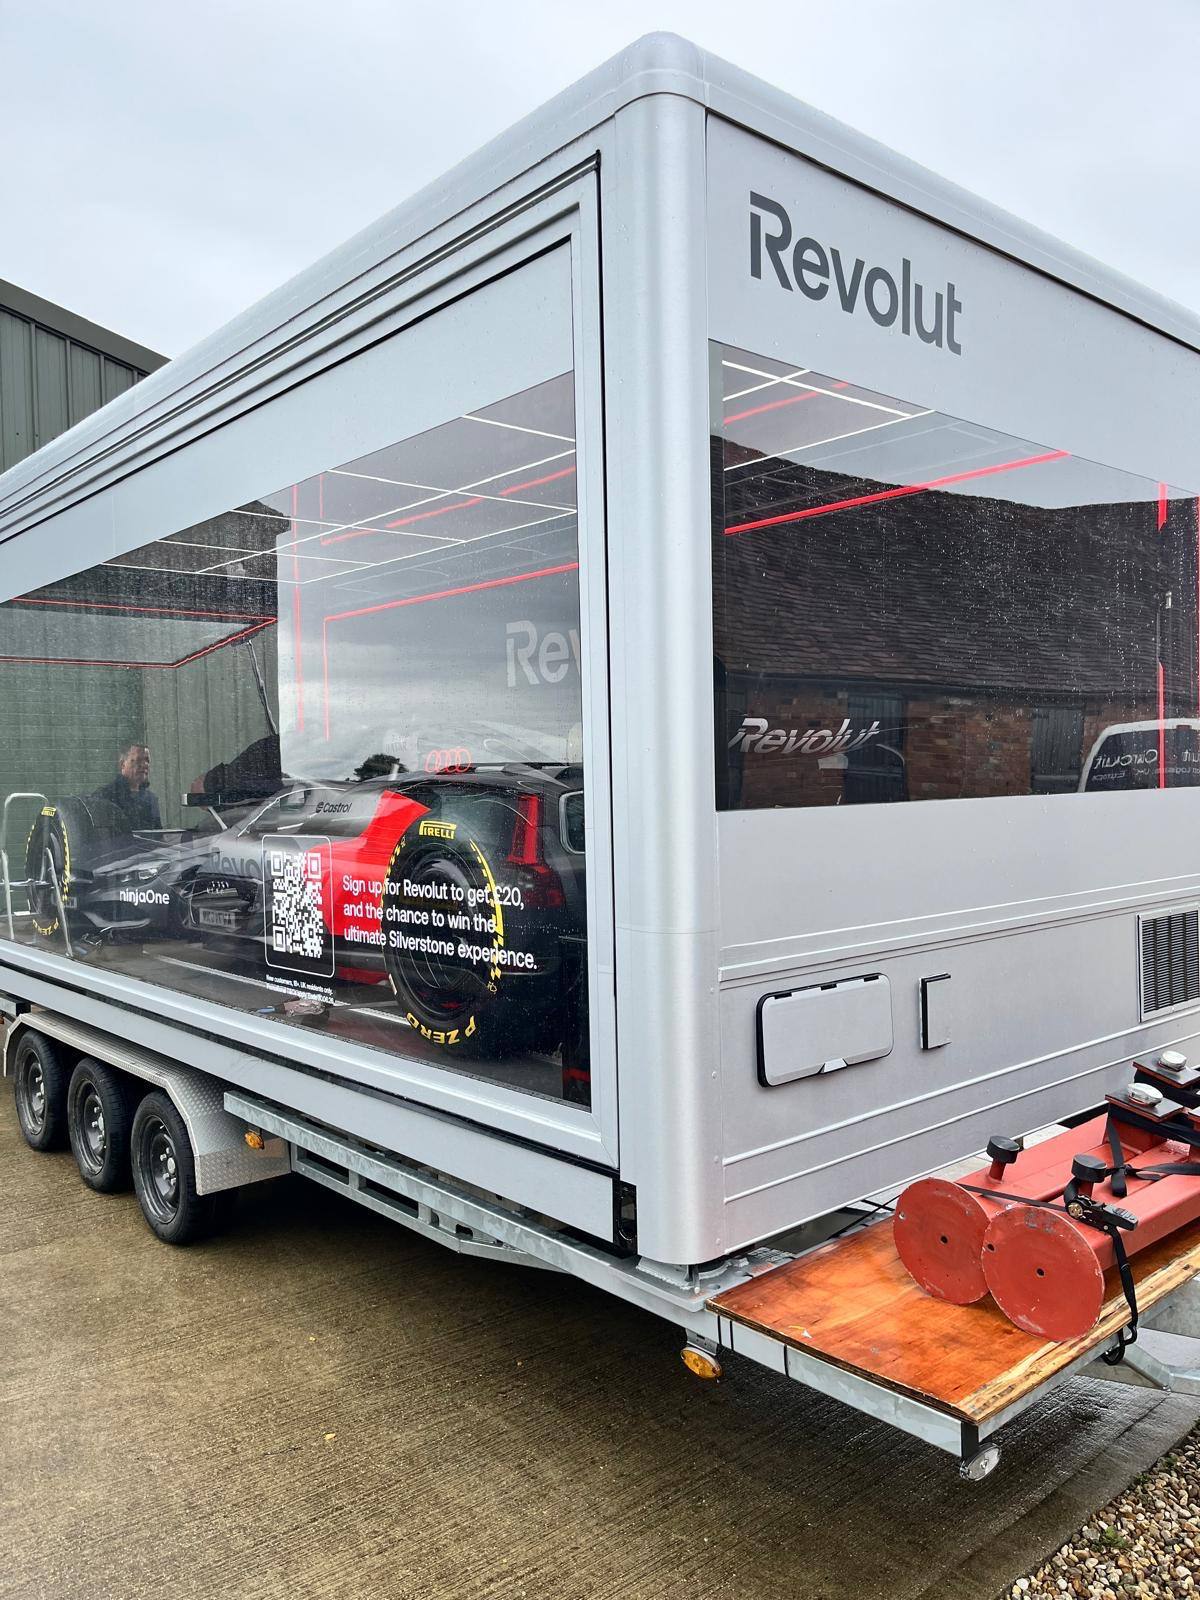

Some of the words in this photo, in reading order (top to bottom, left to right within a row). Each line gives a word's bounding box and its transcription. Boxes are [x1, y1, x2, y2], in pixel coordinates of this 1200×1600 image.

[749, 190, 962, 356] Revolut
[728, 717, 880, 754] Revolut
[323, 801, 352, 814] Castrol
[419, 820, 457, 840] PIRELLI
[119, 888, 170, 907] ninjaOne
[342, 875, 366, 896] Sign
[368, 880, 382, 898] up
[384, 878, 401, 895] for
[403, 879, 449, 900] Revolut
[450, 883, 464, 901] to
[467, 886, 491, 907] get
[494, 885, 525, 911] £20,
[343, 902, 364, 918] and
[365, 902, 384, 920] the
[386, 904, 429, 926] chance
[431, 909, 445, 927] to
[447, 911, 471, 931] win
[473, 913, 496, 933] the
[344, 925, 387, 946] ultimate
[389, 930, 455, 956] Silverstone
[457, 943, 538, 969] experience.
[406, 1012, 460, 1045] ZERO
[465, 1015, 476, 1037] P
